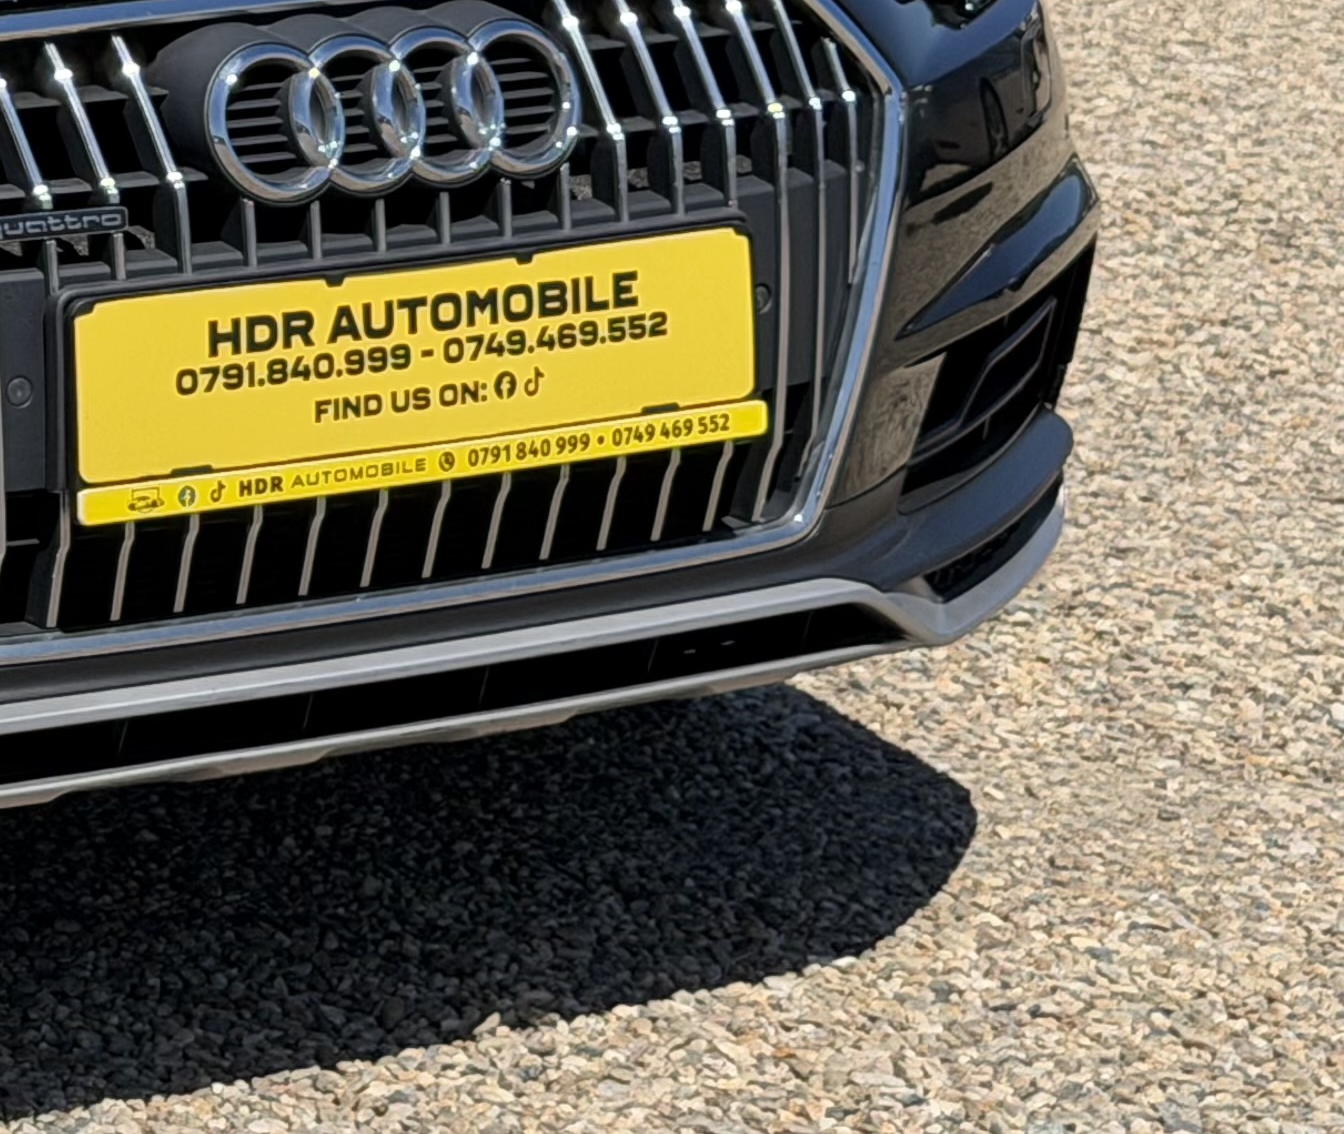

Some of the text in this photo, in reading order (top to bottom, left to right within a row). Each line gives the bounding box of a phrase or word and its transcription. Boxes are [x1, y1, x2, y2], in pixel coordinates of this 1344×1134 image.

[175, 343, 411, 396] 0791.840.999
[443, 311, 668, 364] 0749.469.552
[208, 270, 639, 358] HDR AUTOMOBILE
[314, 380, 488, 424] FIND US ON:
[239, 413, 730, 498] HDR AUTOMOBILE 0791 840 999 0749 469 552
